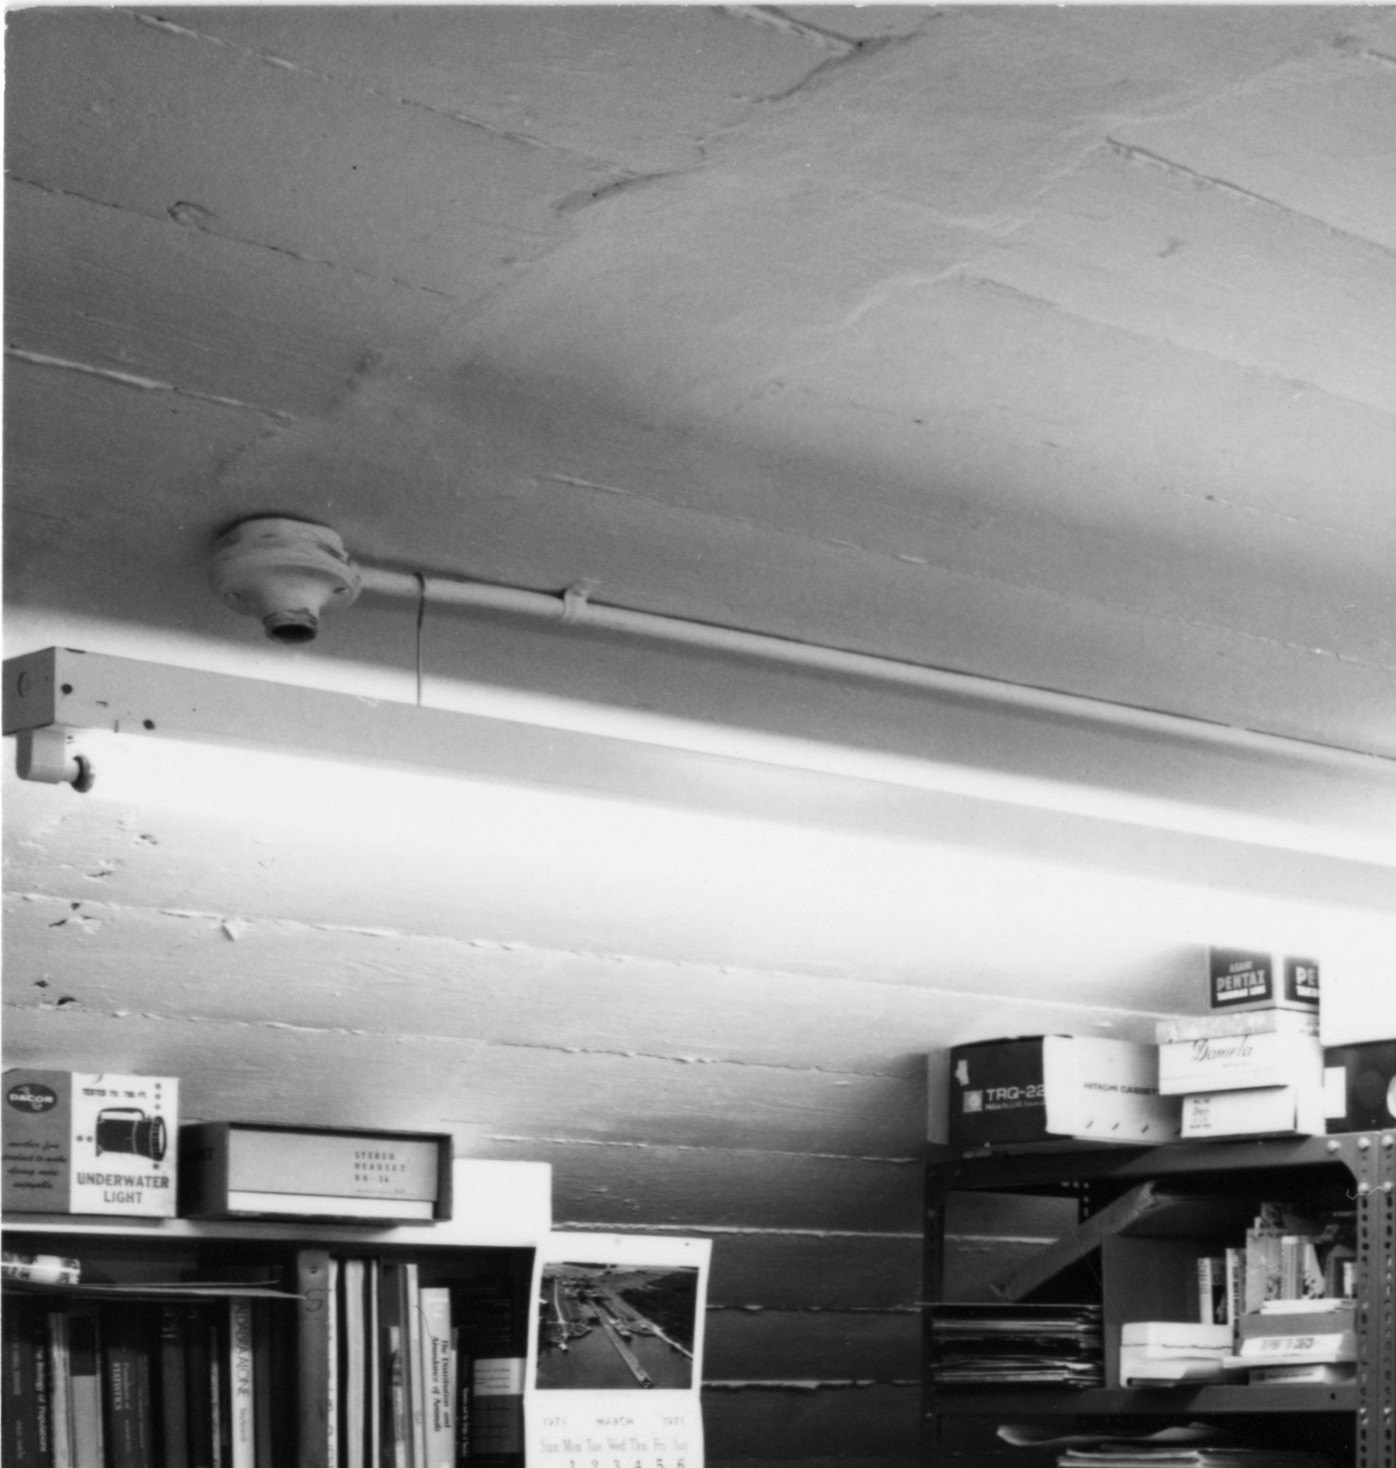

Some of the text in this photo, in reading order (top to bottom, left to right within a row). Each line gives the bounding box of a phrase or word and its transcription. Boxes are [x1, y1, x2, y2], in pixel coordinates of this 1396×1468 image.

[1216, 969, 1266, 991] PENTAX
[1295, 966, 1319, 986] PE
[985, 1084, 1044, 1102] TRQ-22
[1084, 1081, 1118, 1092] HITACHI
[9, 1092, 54, 1104] DACOR
[354, 1151, 396, 1161] STEREO
[354, 1162, 406, 1173] HEADSET
[77, 1172, 170, 1189] UNDERWATER
[104, 1191, 143, 1204] LIGHT
[35, 1361, 45, 1392] Biology
[236, 1356, 250, 1398] ALONE
[431, 1336, 442, 1432] Abundance of Animals
[441, 1340, 451, 1429] The Distribution and
[113, 1362, 123, 1411] STATISTICS
[37, 1405, 48, 1452] Populations
[595, 1417, 634, 1426] MARCH
[563, 1439, 582, 1452] Mon
[606, 1438, 626, 1451] Wed
